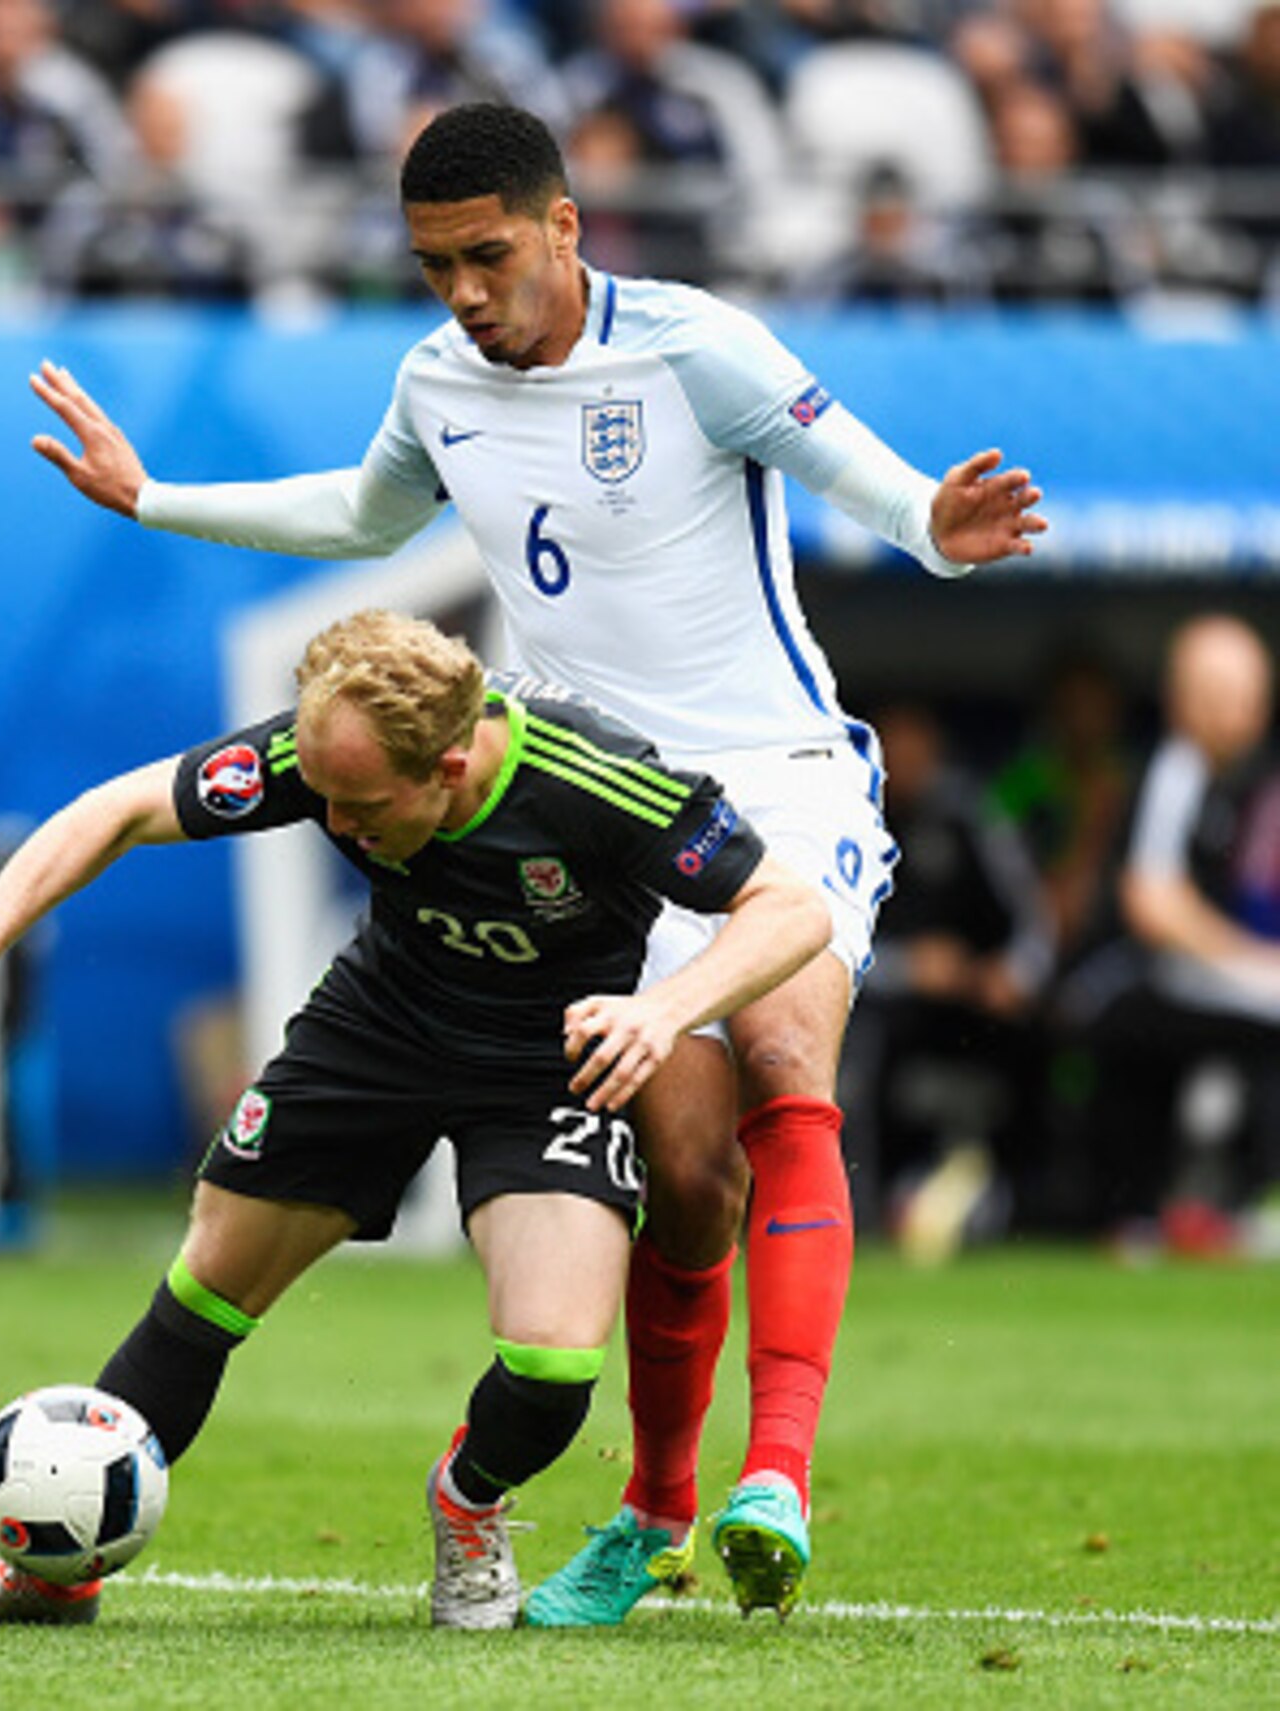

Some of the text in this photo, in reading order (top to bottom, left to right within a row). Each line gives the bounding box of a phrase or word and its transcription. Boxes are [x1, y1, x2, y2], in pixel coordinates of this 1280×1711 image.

[526, 503, 570, 596] 6
[416, 907, 540, 962] 20
[542, 1106, 640, 1191] 20
